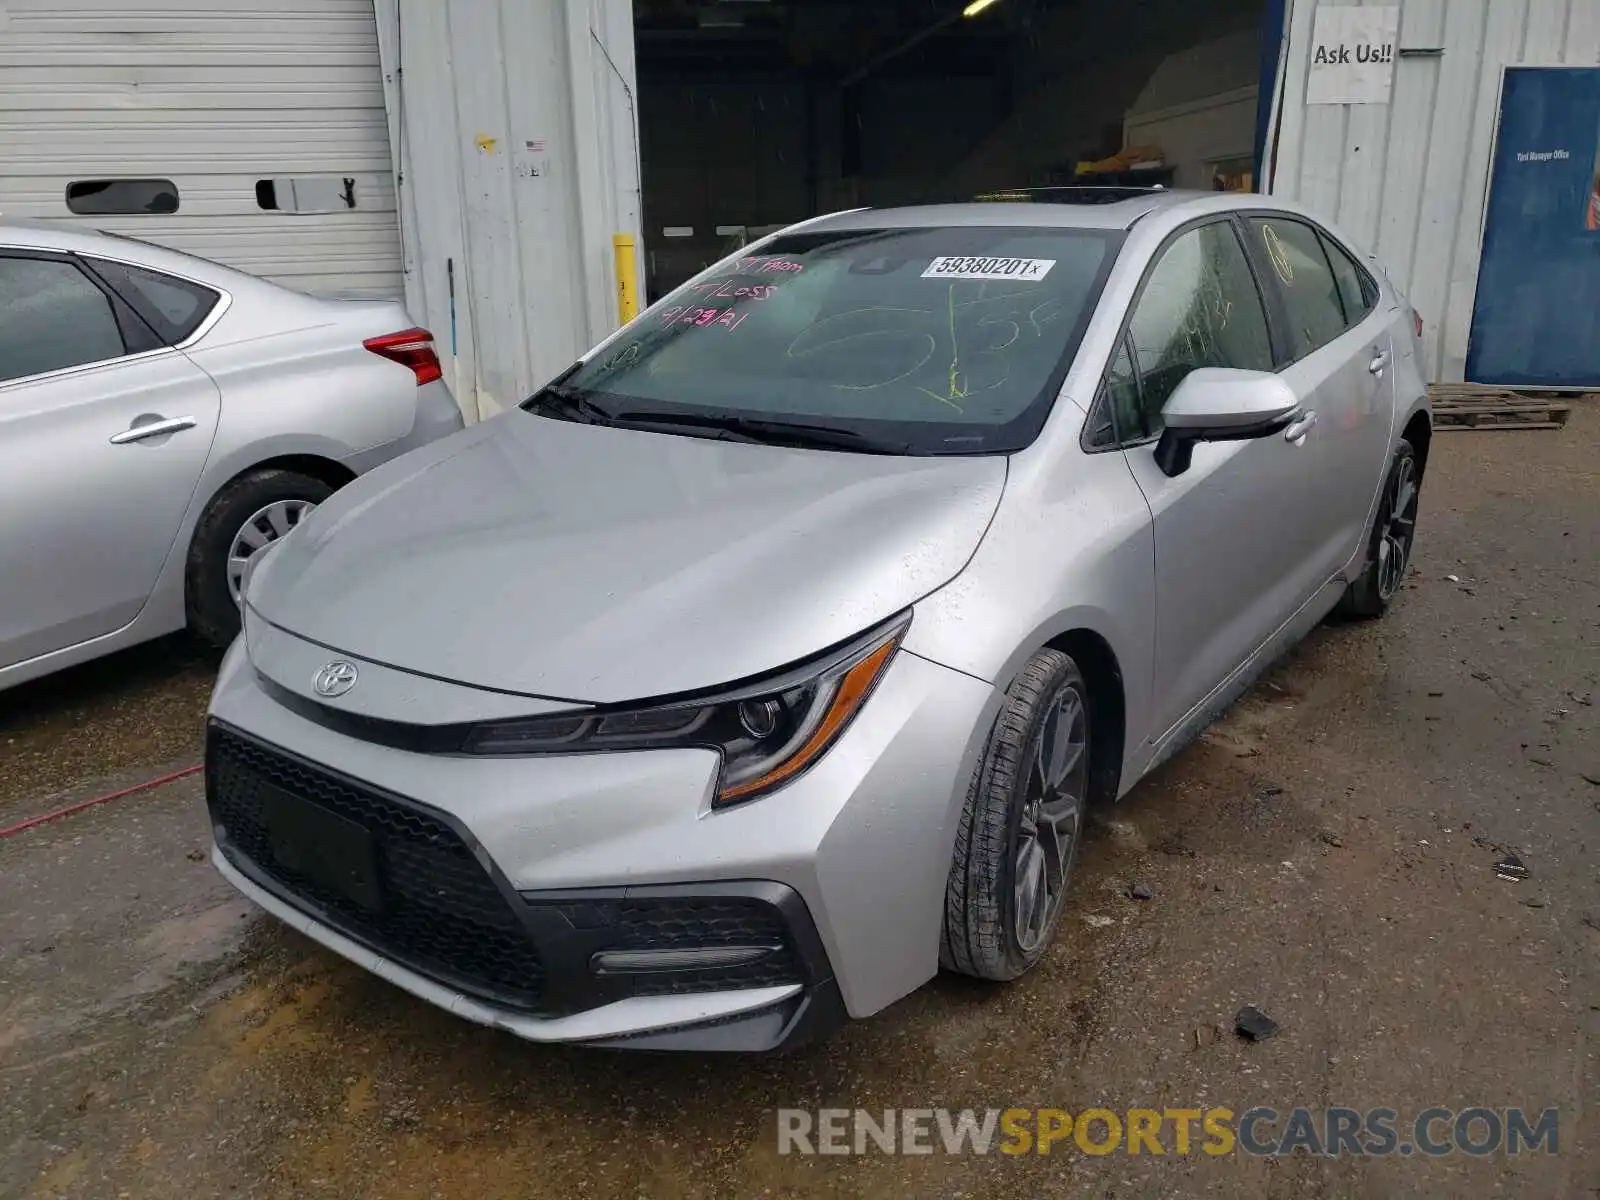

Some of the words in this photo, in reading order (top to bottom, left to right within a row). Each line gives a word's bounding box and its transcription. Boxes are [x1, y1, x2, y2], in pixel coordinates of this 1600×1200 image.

[1314, 44, 1350, 64] Ask
[1356, 44, 1391, 63] Us!!
[1553, 148, 1570, 159] Office
